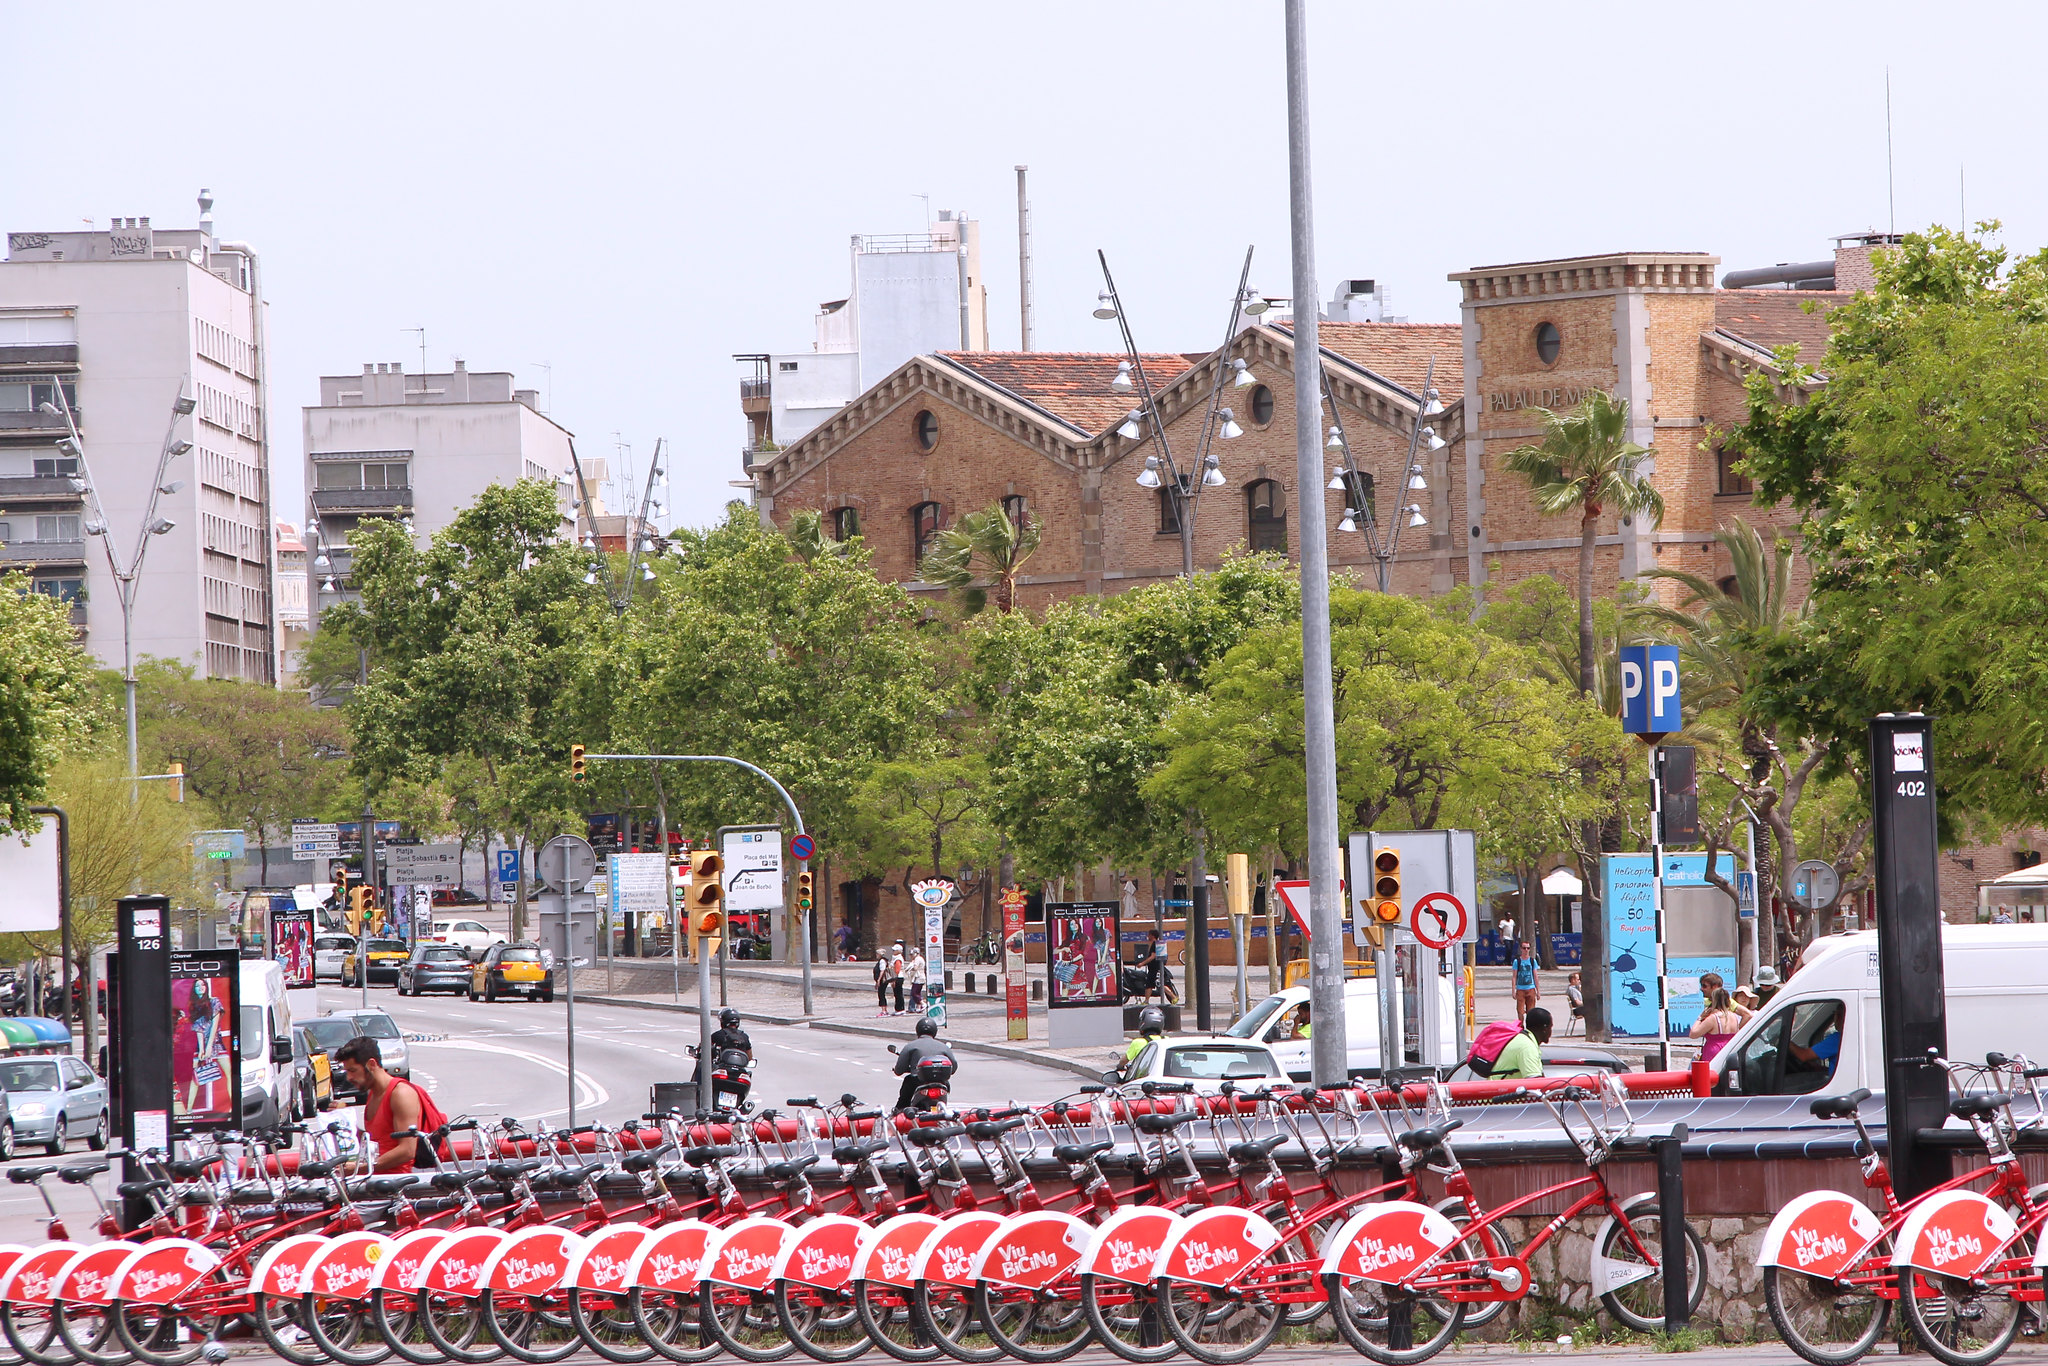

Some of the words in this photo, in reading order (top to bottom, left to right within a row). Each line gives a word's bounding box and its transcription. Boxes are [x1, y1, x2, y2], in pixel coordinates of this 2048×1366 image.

[1490, 389, 1536, 411] PALAU
[1541, 387, 1561, 408] DE
[1621, 661, 1642, 718] P
[1653, 660, 1678, 717] P
[1897, 781, 1926, 797] 402
[502, 852, 514, 870] P
[1615, 867, 1654, 877] Helicopte
[1667, 871, 1733, 880] cathelicoers
[1620, 891, 1650, 906] flights
[1628, 908, 1643, 920] 50
[1620, 924, 1634, 936] Buy
[137, 939, 160, 950] 126
[1352, 1236, 1384, 1256] Viu
[1790, 1226, 1818, 1248] Viu
[1924, 1226, 1952, 1248] Viu
[722, 1246, 750, 1264] Viu
[798, 1246, 824, 1264] Viu
[876, 1245, 904, 1263] Viu
[936, 1244, 964, 1262] Viu
[998, 1244, 1027, 1262] Viu
[1106, 1238, 1134, 1257] Viu
[1180, 1238, 1209, 1258] Viu
[1795, 1234, 1847, 1267] BiCiNg
[1929, 1234, 1982, 1267] BiCiNg
[393, 1257, 418, 1273] Viu
[439, 1256, 466, 1274] Viu
[501, 1256, 529, 1274] Viu
[588, 1254, 613, 1271] Viu
[648, 1253, 675, 1270] Viu
[727, 1252, 776, 1280] BiCiNg
[802, 1252, 850, 1280] BiCiNg
[1002, 1250, 1058, 1279] BiCiNg
[1184, 1246, 1239, 1276] BiCiNg
[1358, 1242, 1416, 1274] BiCiNg
[18, 1270, 44, 1286] Viu
[72, 1268, 99, 1285] Viu
[129, 1268, 156, 1285] Viu
[272, 1262, 298, 1278] Viu
[320, 1262, 347, 1278] Viu
[506, 1260, 556, 1289] BiCiNg
[1610, 1268, 1632, 1278] 25243
[133, 1271, 182, 1298] BiCiNg
[325, 1266, 372, 1293] BiCiNg
